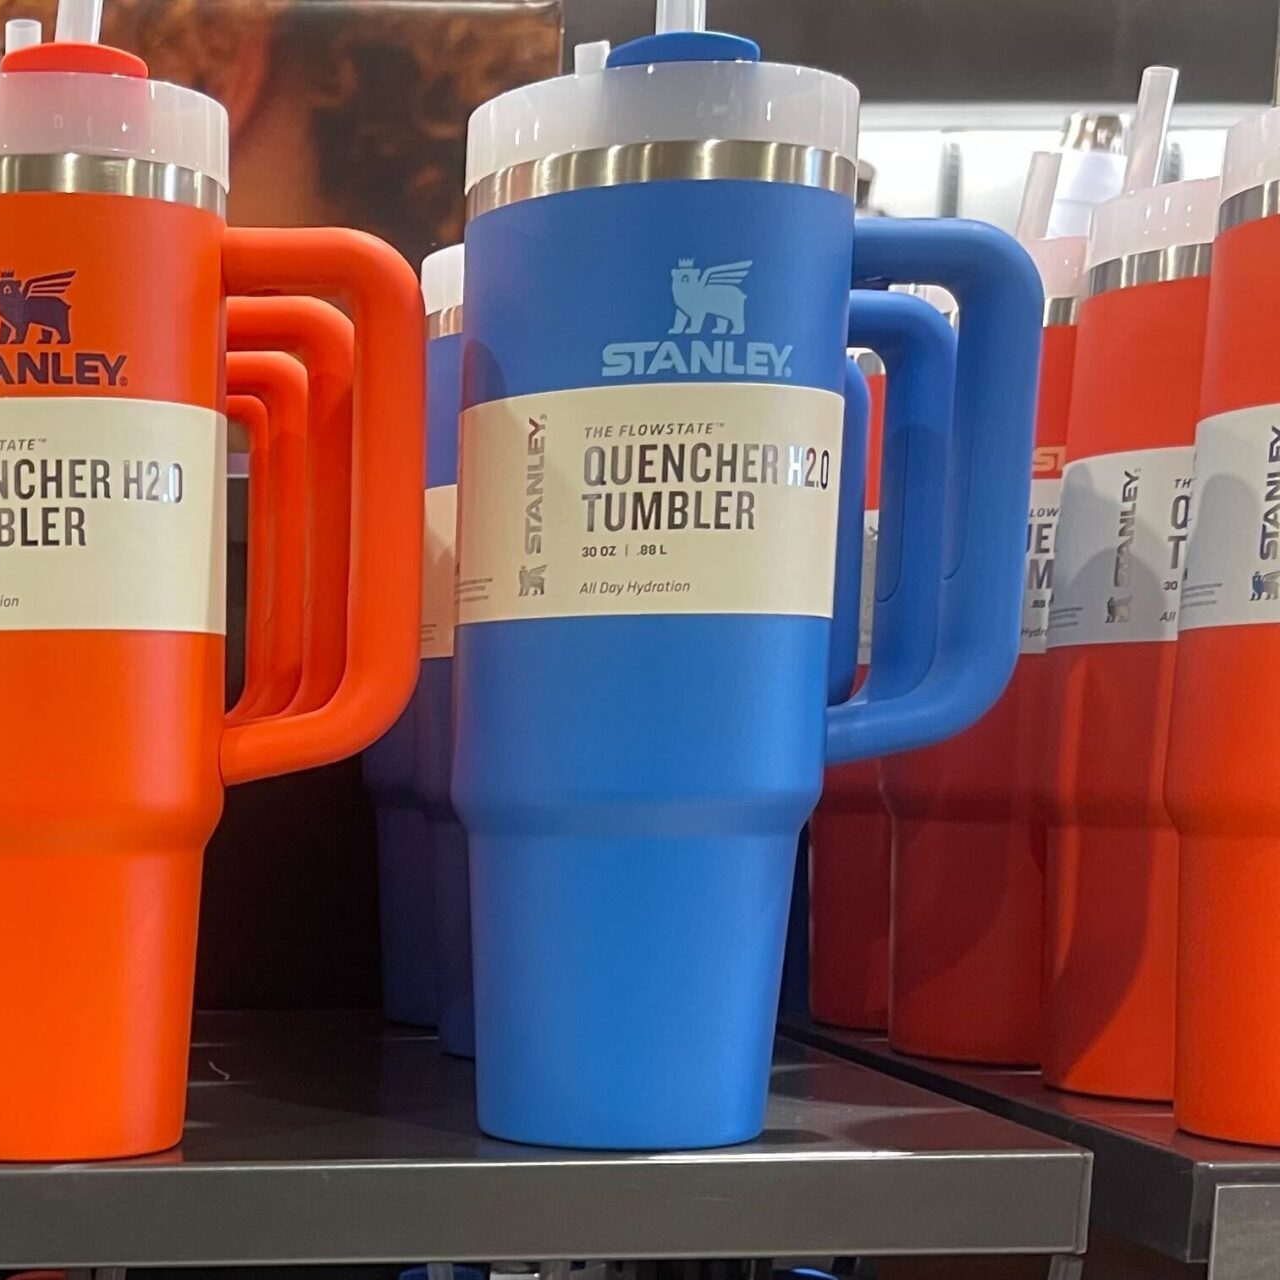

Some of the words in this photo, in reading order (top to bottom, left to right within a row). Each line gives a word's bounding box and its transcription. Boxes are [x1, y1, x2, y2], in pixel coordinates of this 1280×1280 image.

[584, 425, 614, 439] THE
[583, 443, 779, 487] QUENCHER
[787, 445, 831, 491] H2.0
[123, 461, 184, 504] H2.0
[1174, 478, 1192, 489] TH
[582, 490, 755, 533] TUMBLER
[581, 546, 597, 558] 30
[600, 545, 617, 557] OZ
[659, 544, 668, 555] L
[579, 581, 597, 594] All
[600, 581, 624, 597] Day
[626, 580, 691, 597] Hydration
